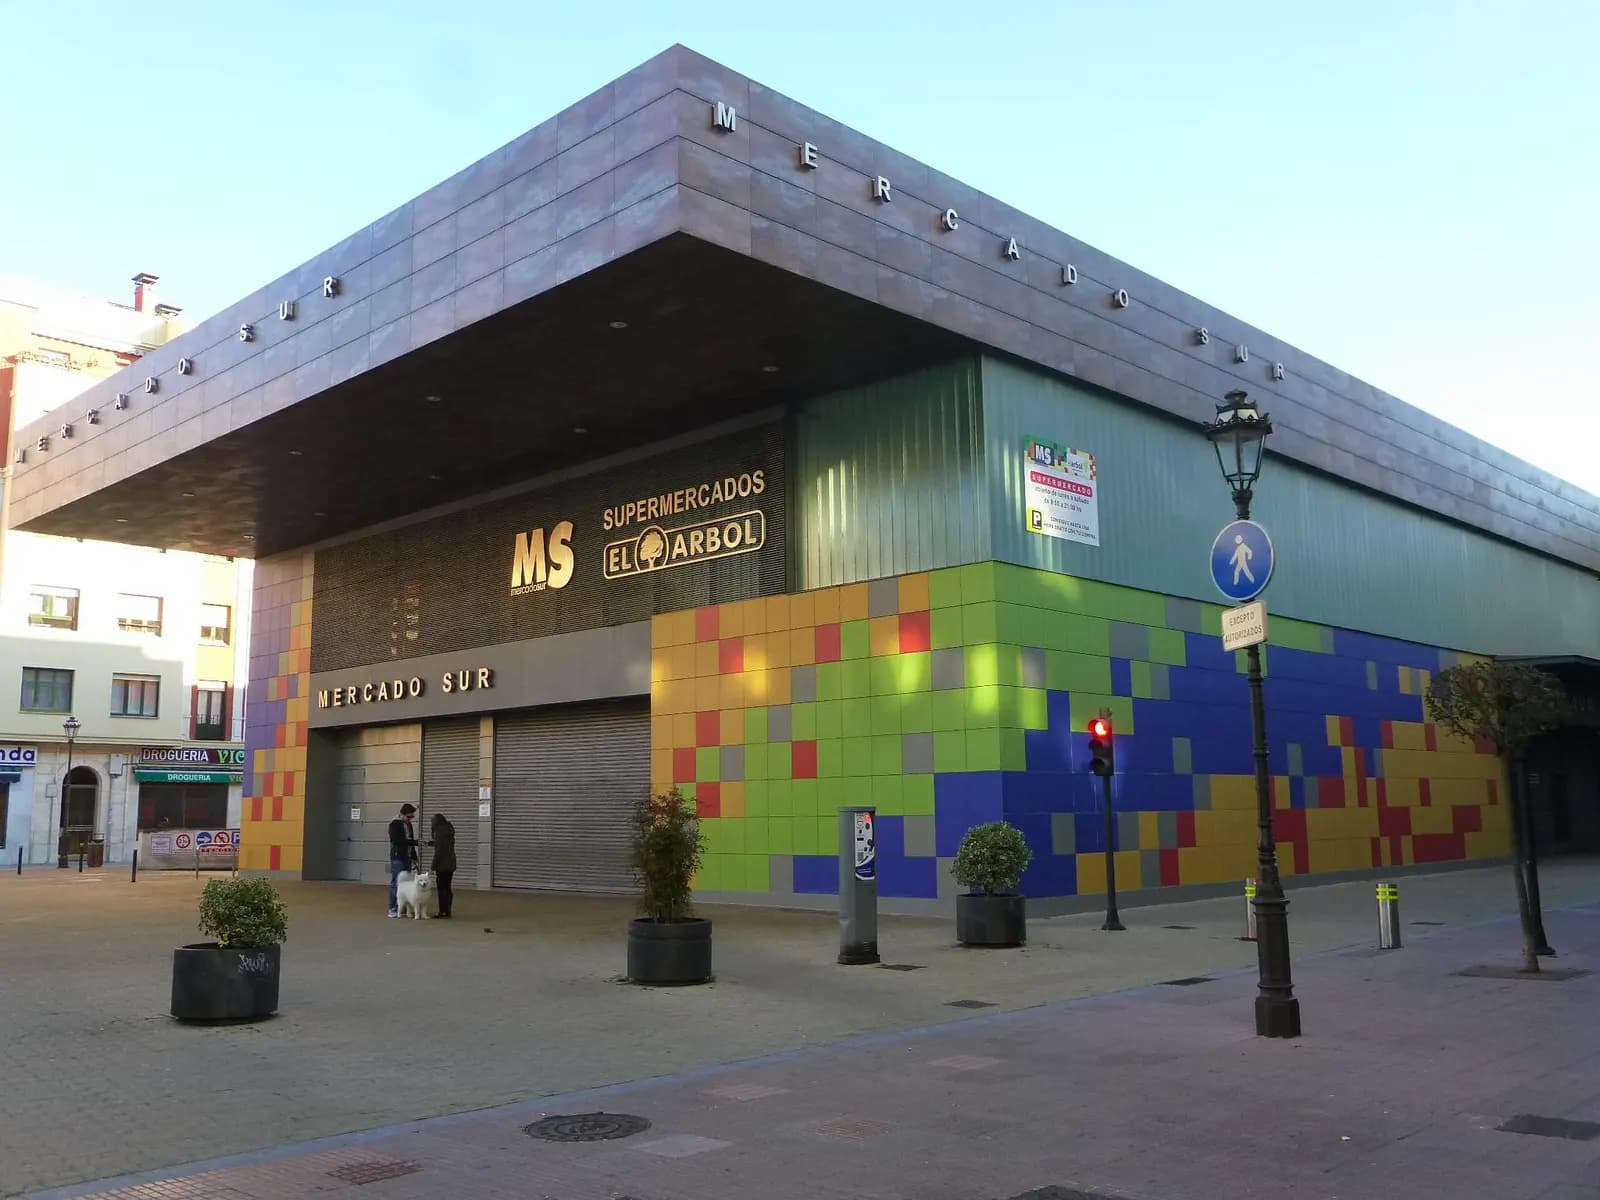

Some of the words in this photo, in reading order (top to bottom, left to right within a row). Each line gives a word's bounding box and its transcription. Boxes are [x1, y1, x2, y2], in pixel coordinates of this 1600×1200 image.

[711, 101, 1128, 307] MERCADO
[1198, 327, 1285, 380] SUR
[15, 357, 191, 463] MERCADO
[240, 276, 335, 341] SUR
[1035, 445, 1052, 465] MS
[603, 469, 765, 531] SUPERMERCADOS
[1031, 473, 1092, 496] SUPERMERCADO
[511, 520, 575, 589] MS
[609, 547, 632, 572] EL
[672, 518, 757, 560] ARBOL
[1225, 625, 1262, 642] AUTORIZADOS
[1229, 611, 1255, 626] EXCEPTO
[318, 676, 423, 709] MERCADO
[442, 667, 490, 693] SUR
[143, 749, 209, 761] DROGUERIA
[167, 773, 211, 782] DROGUERIA
